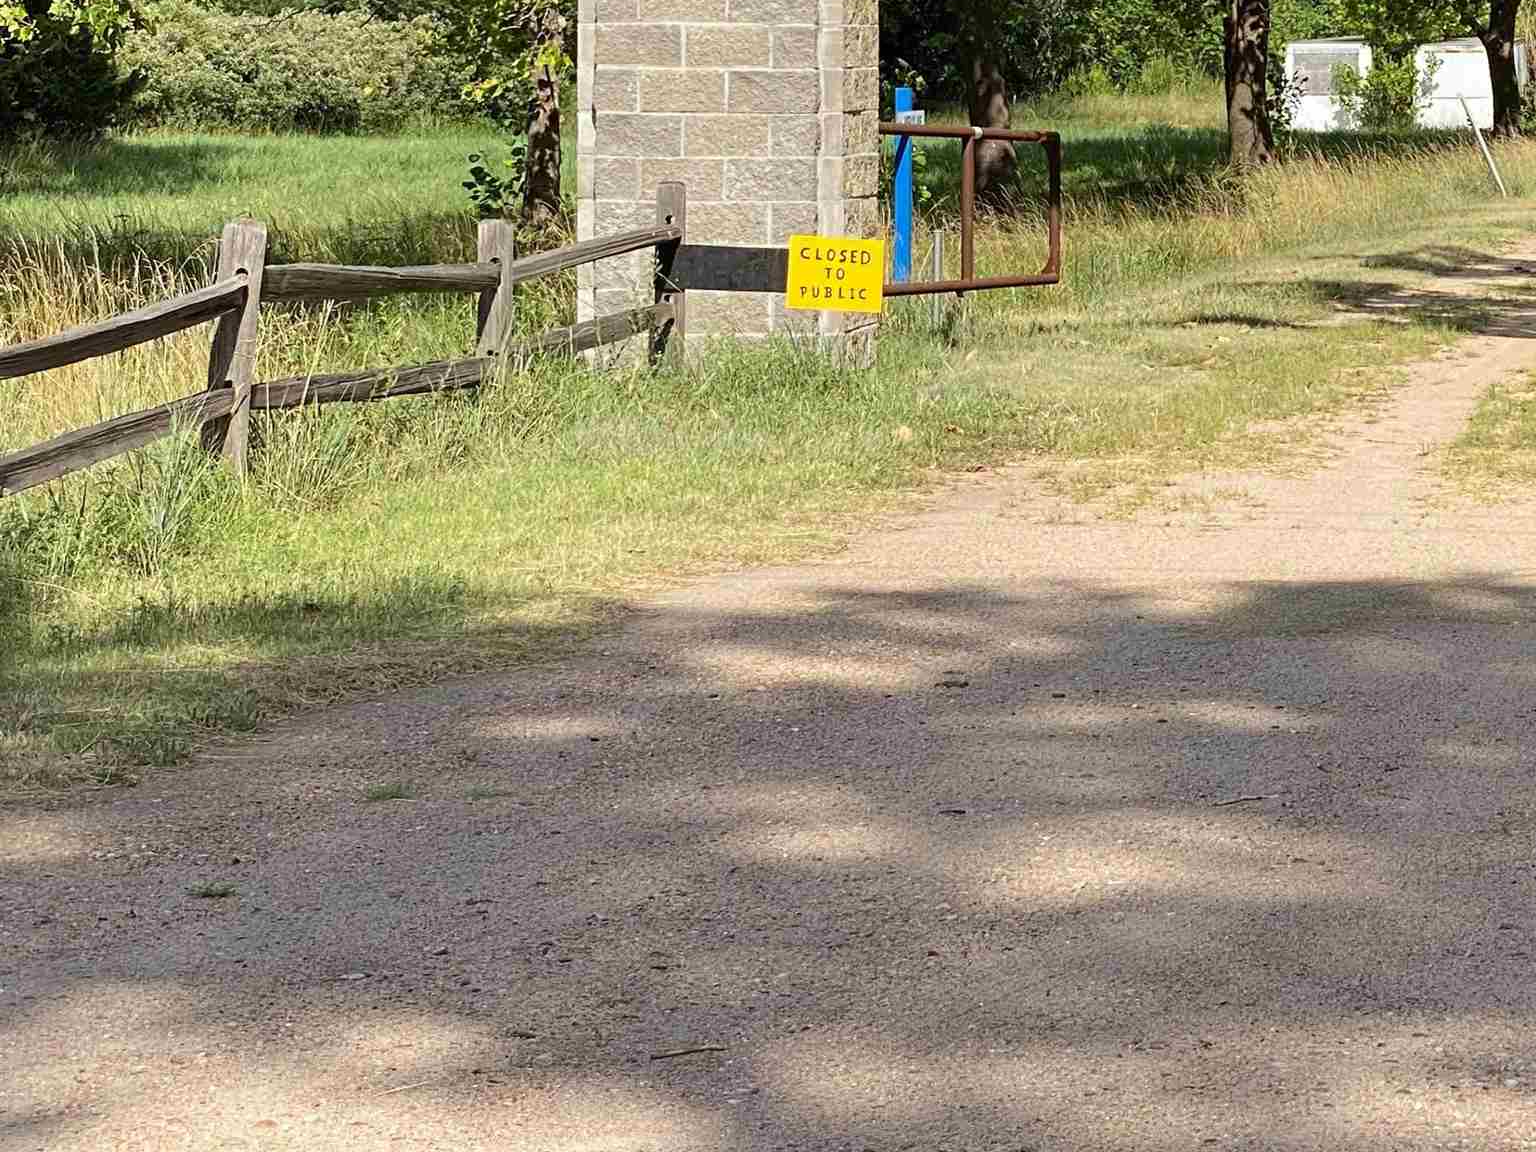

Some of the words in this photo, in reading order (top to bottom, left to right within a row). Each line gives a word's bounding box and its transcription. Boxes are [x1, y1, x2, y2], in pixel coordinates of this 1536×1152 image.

[800, 247, 871, 265] CLOSED
[825, 267, 845, 281] TO
[799, 285, 867, 300] PUBLIC
